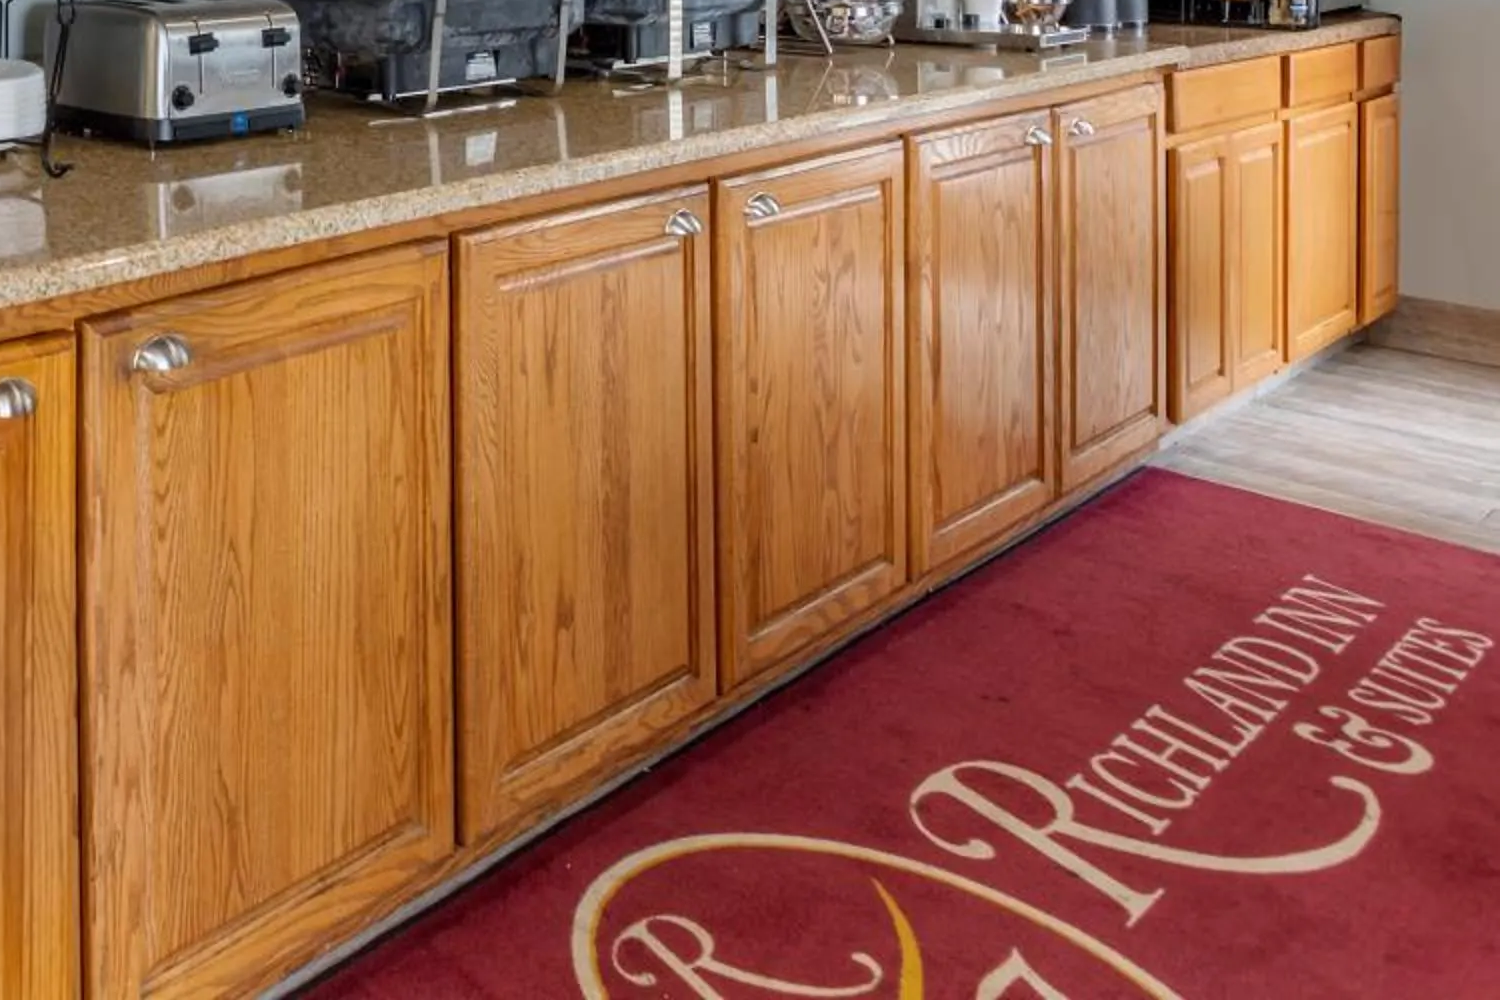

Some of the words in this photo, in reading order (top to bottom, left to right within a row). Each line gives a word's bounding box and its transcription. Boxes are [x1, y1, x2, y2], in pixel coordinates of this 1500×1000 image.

[910, 636, 1380, 928] RICHLAND
[1253, 574, 1386, 654] INN
[1347, 616, 1494, 725] SUITES
